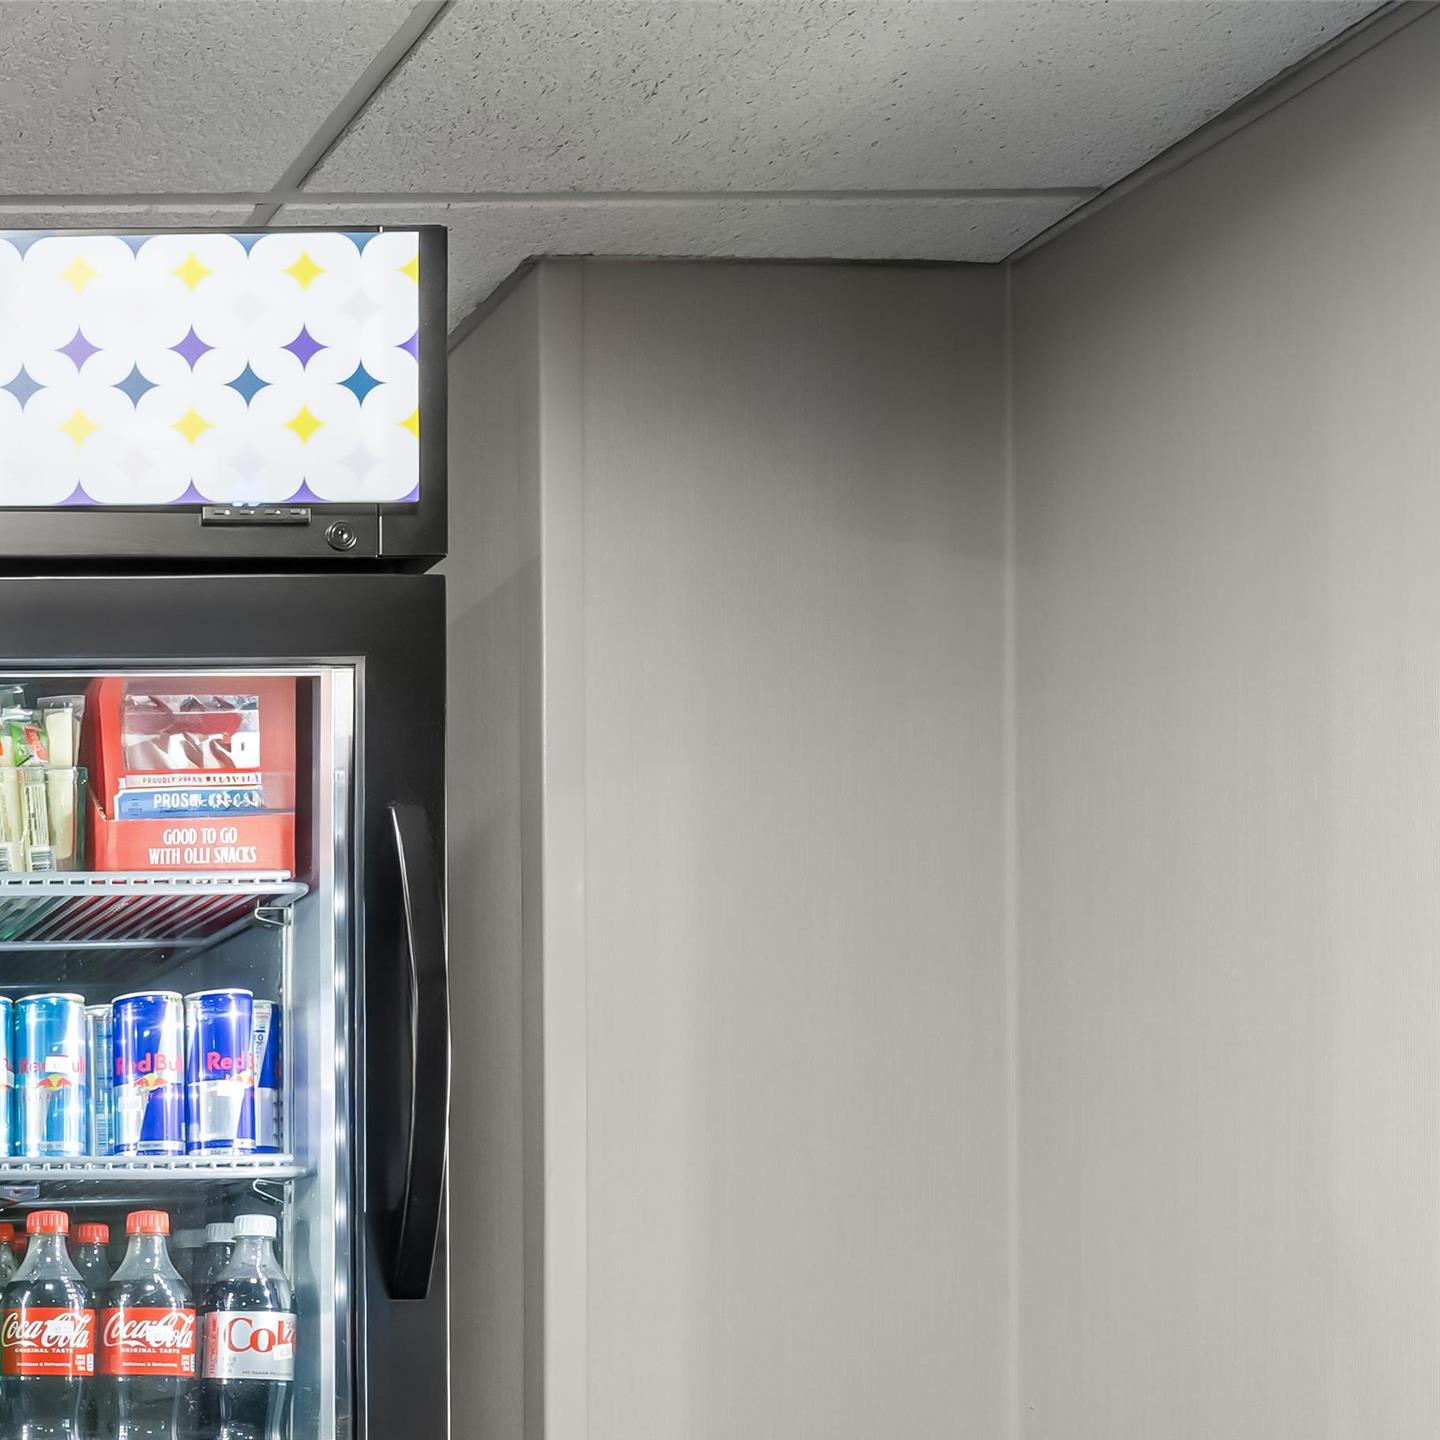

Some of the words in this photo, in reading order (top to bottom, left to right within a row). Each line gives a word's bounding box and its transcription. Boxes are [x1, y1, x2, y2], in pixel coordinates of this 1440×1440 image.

[163, 828, 199, 845] GOOD
[202, 828, 216, 844] TO
[220, 827, 237, 843] GO
[149, 848, 181, 864] WITH
[184, 847, 210, 864] OLLI
[212, 846, 257, 864] SNACKS
